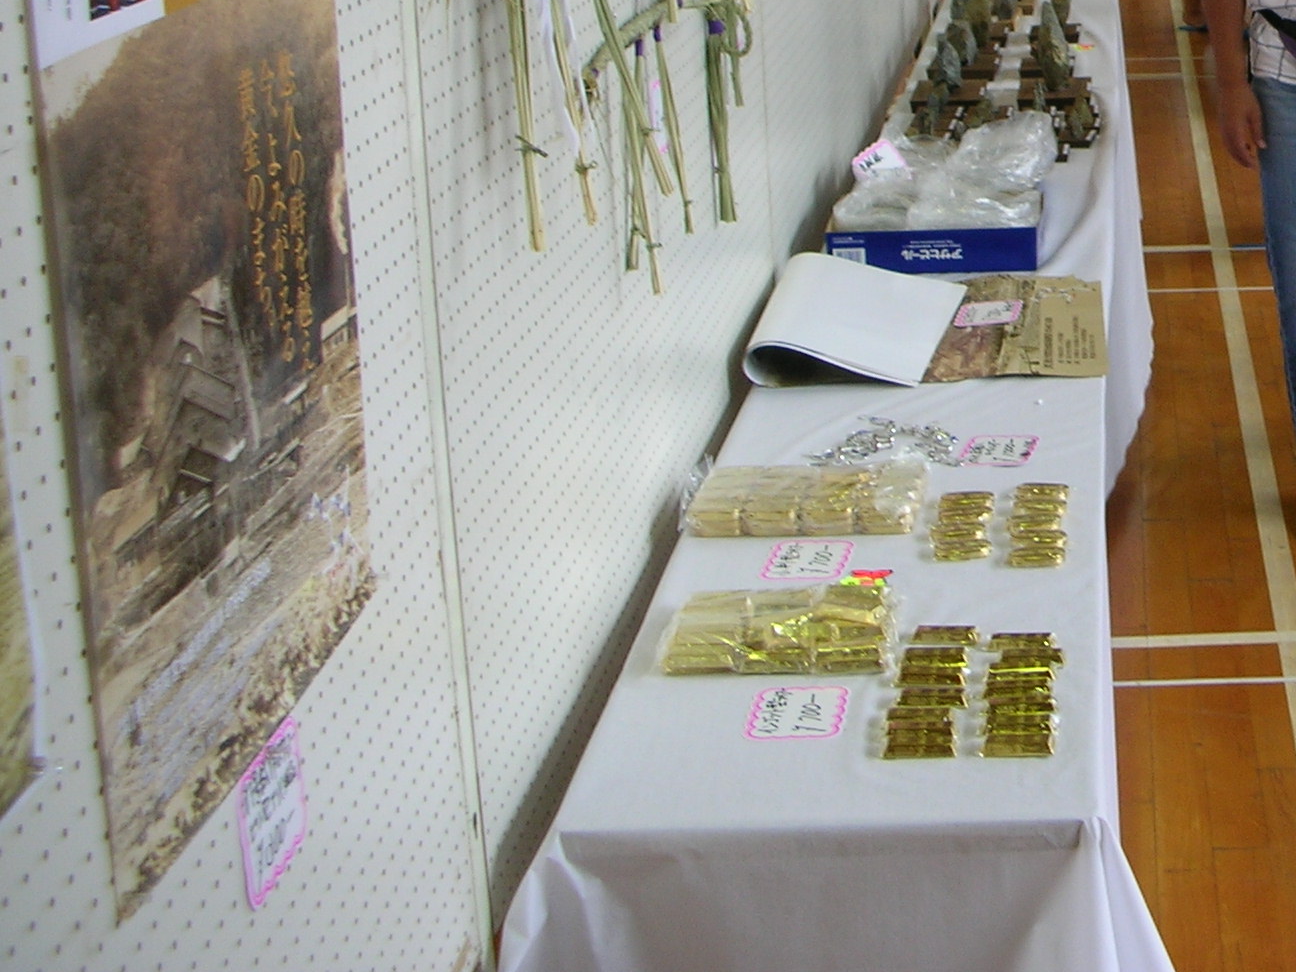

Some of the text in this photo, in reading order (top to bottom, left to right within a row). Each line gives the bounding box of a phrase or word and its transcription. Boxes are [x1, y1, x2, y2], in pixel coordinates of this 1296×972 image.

[902, 248, 964, 261] アサヒビール
